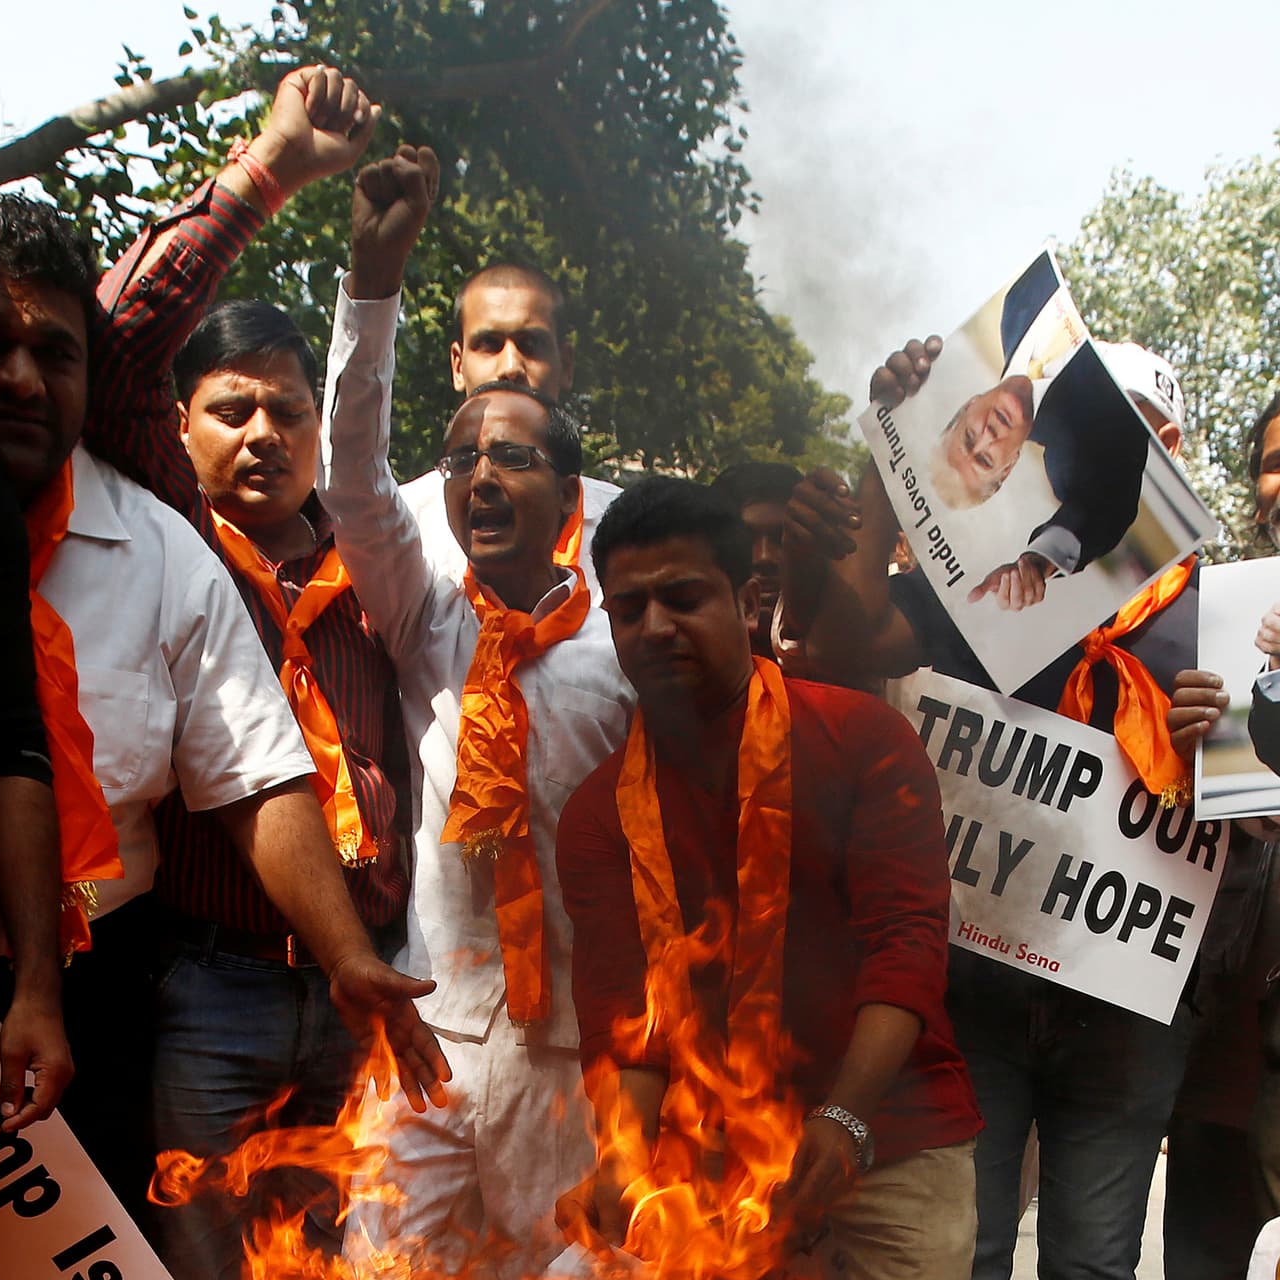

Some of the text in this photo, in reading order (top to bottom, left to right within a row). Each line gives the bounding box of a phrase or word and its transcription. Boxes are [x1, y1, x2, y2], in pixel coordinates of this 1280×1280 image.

[876, 403, 966, 588] India Loves Trump
[917, 695, 1222, 873] TRUMP OUR
[944, 814, 1196, 963] LY HOPE
[957, 921, 1061, 974] Hindu Sena
